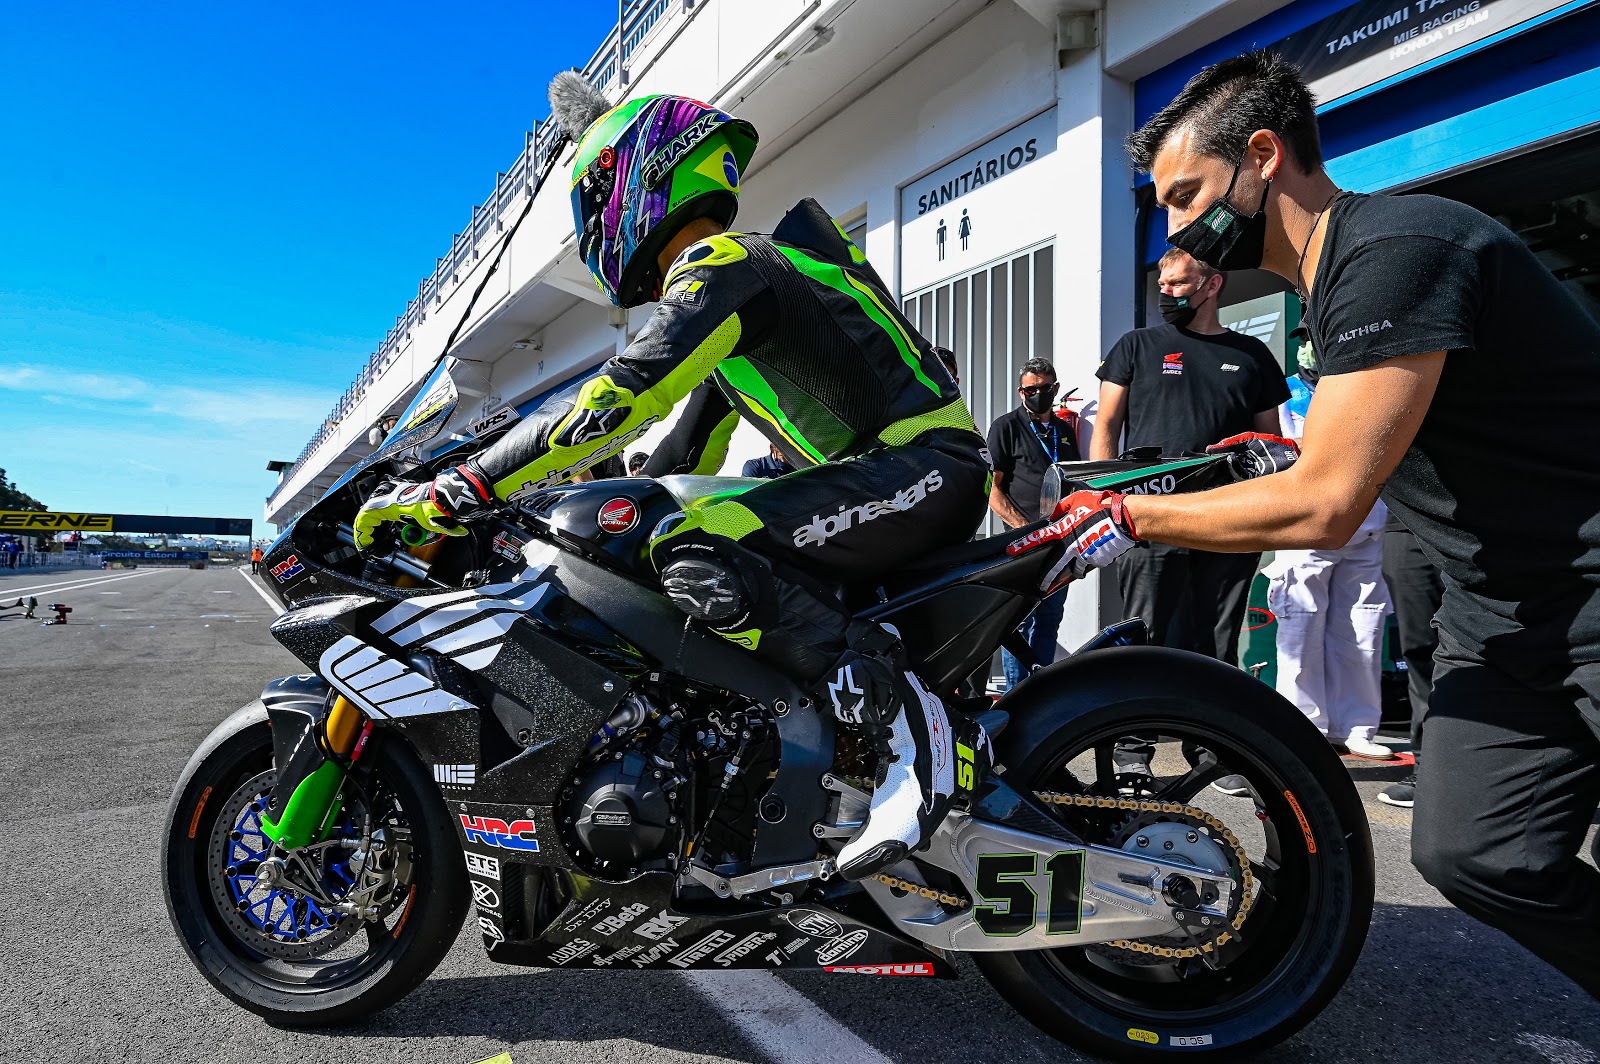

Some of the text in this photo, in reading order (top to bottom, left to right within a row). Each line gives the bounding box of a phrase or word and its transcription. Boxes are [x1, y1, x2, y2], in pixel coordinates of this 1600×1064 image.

[1326, 6, 1409, 54] TAKUMI
[1390, 10, 1489, 60] HONDA TEAM
[1393, 1, 1480, 45] MIE RACING
[642, 112, 718, 188] SHARK
[918, 138, 1037, 215] SANITÁRIOS
[1337, 319, 1393, 343] ALTHEA
[474, 410, 508, 434] WRS
[792, 469, 943, 548] alpinestars
[1014, 506, 1093, 552] HONDA
[100, 551, 141, 559] Circuito
[144, 551, 178, 559] Estoril
[459, 813, 540, 852] HRC
[467, 854, 497, 872] ETS
[585, 898, 611, 920] Dry
[972, 849, 1086, 938] 51
[604, 902, 650, 929] Beta
[632, 909, 688, 940] RK
[799, 913, 835, 935] STM
[713, 931, 765, 967] SPIDER
[832, 964, 929, 974] MOTUL
